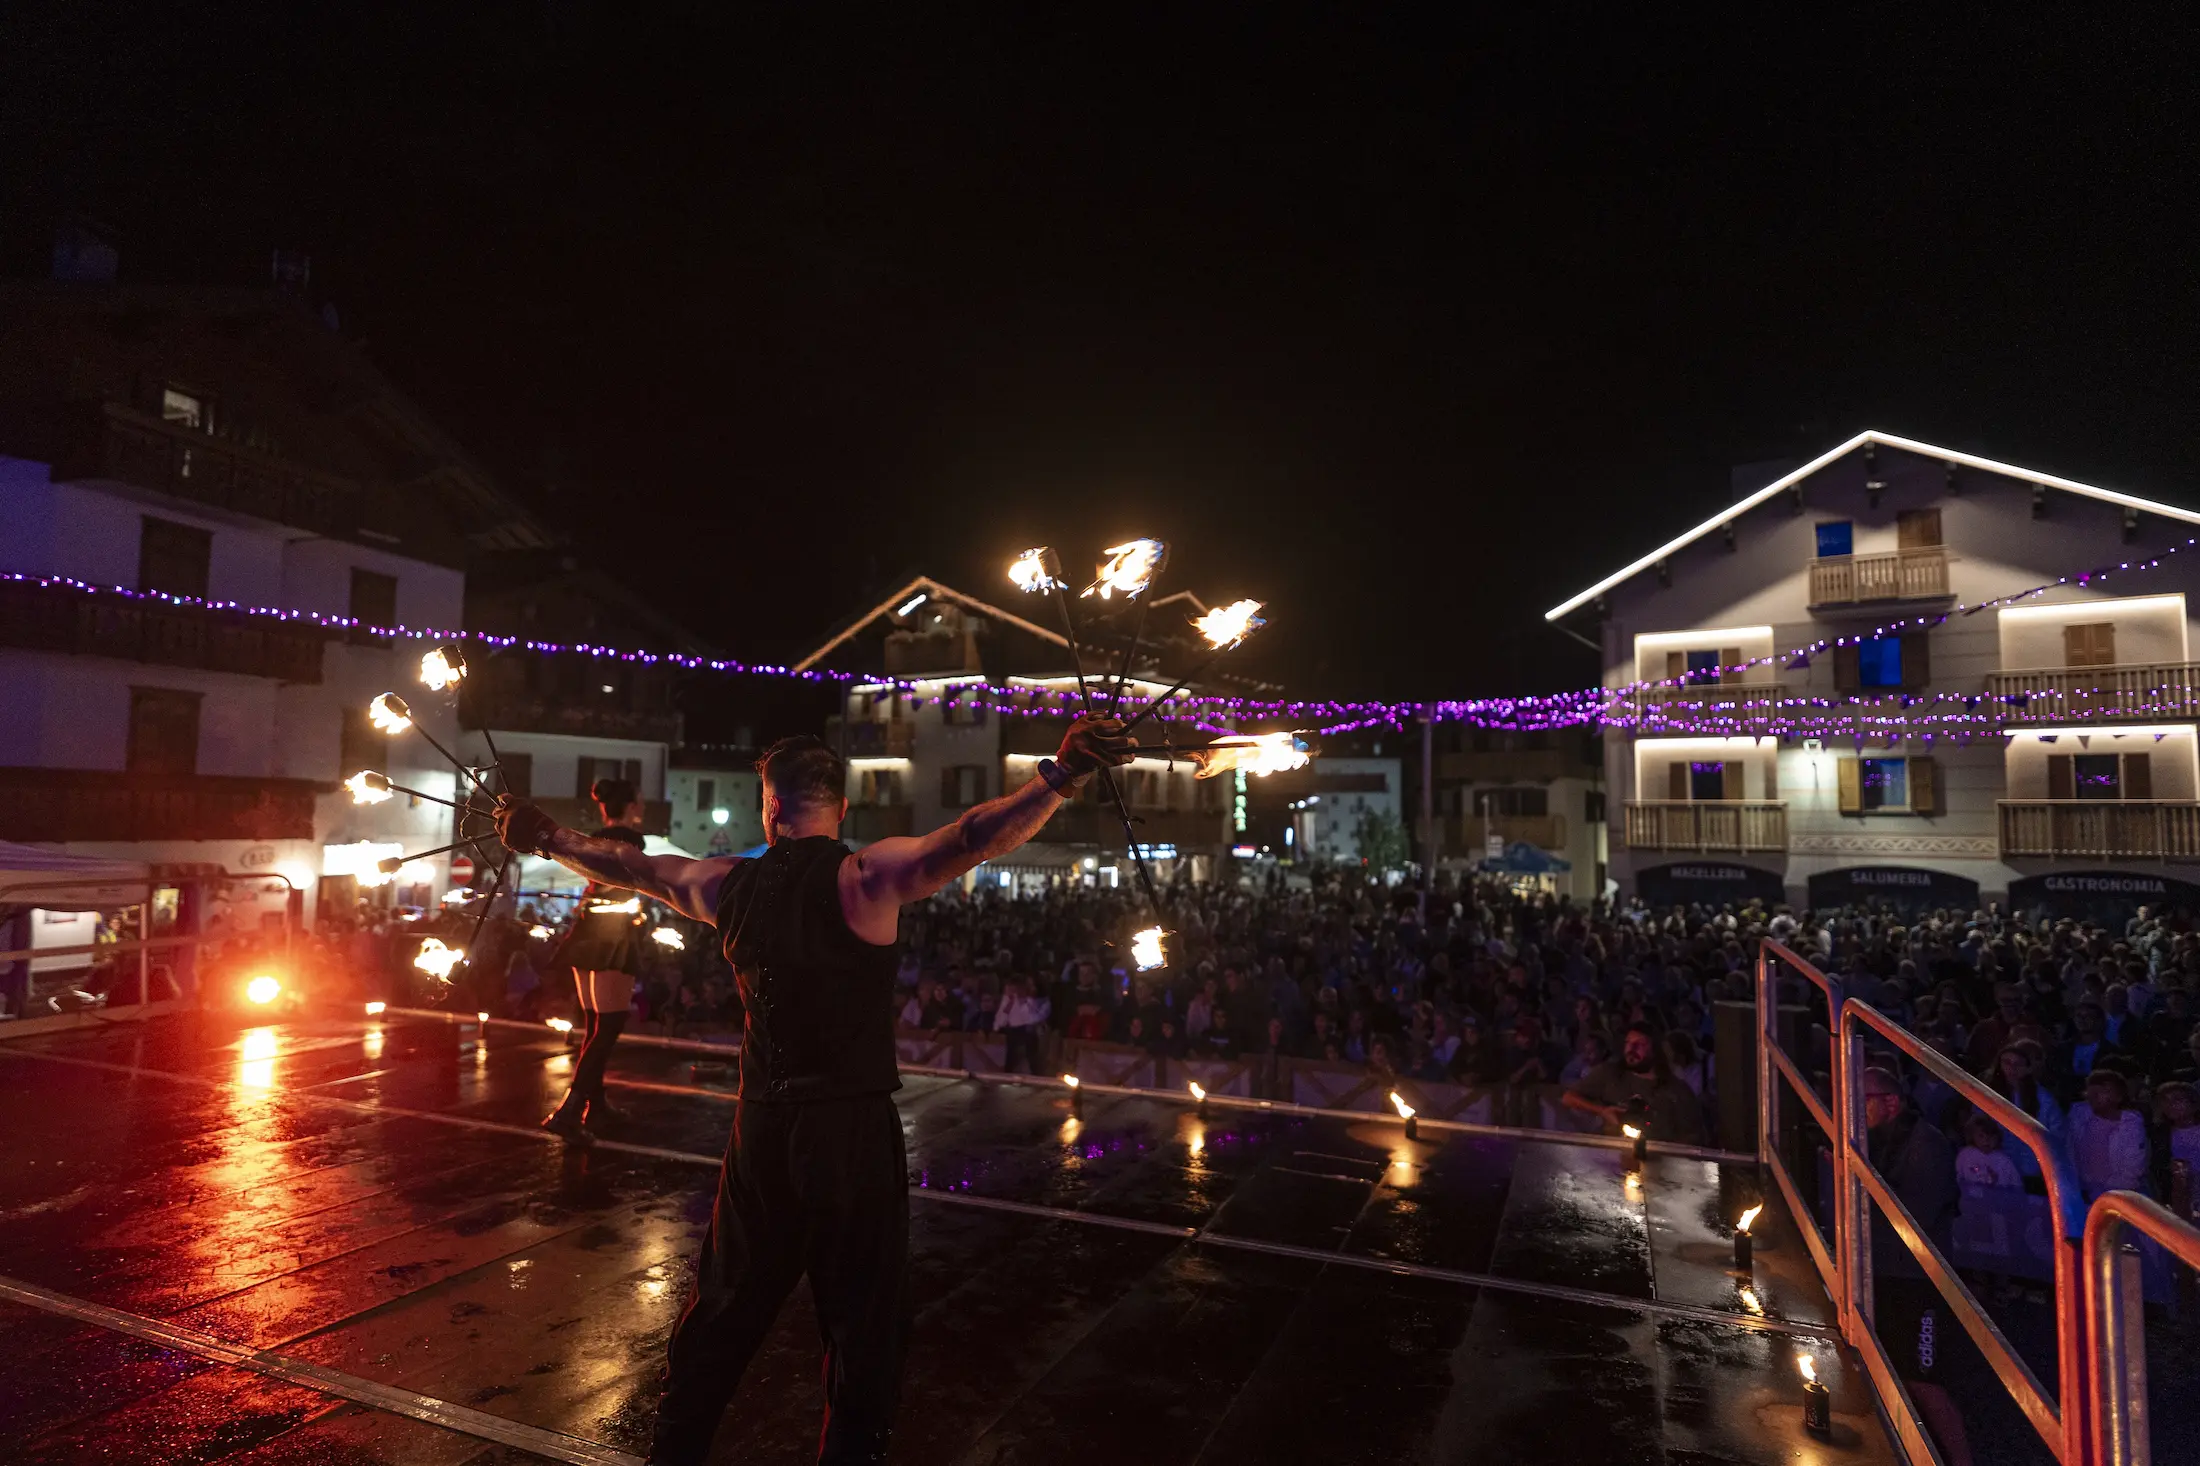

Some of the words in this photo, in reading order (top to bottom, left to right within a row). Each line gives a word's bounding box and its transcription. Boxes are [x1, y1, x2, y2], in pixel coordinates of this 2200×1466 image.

[1670, 866, 1747, 880] MACELLERIA
[1851, 870, 1932, 886] SALUMERIA
[2044, 876, 2167, 893] GASTRONOMIA
[1918, 1316, 1933, 1367] adidas
